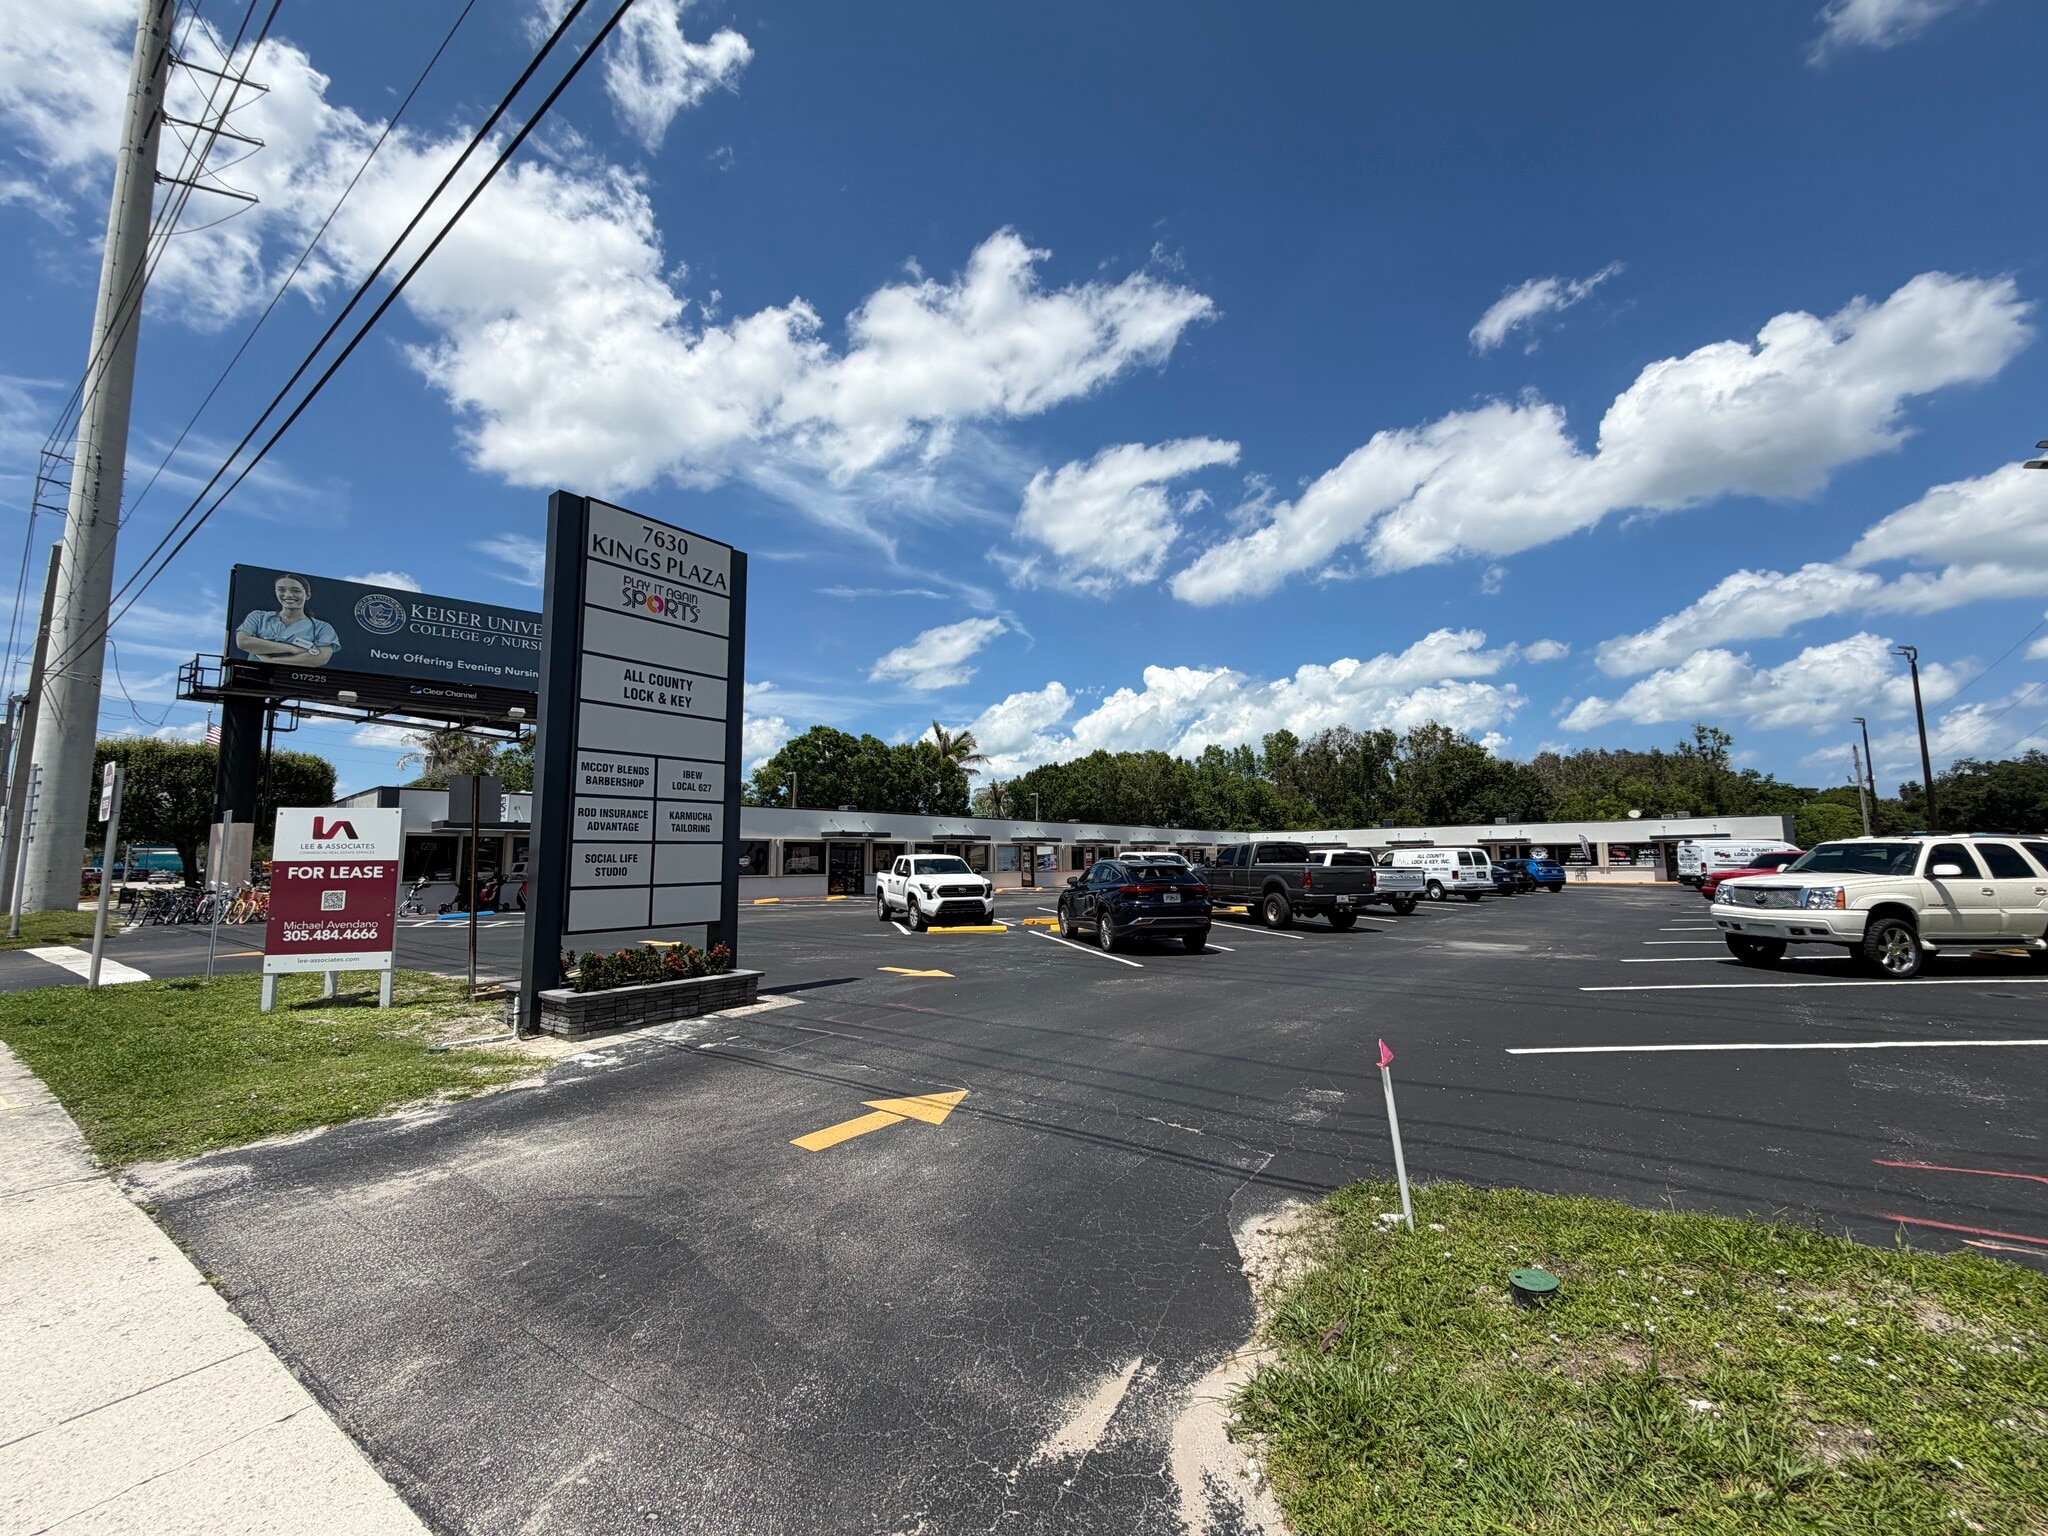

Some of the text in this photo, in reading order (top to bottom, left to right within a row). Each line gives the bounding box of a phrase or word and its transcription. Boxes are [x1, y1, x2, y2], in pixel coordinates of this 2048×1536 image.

[642, 525, 688, 556] 7630
[592, 533, 727, 591] KINGS PLAZA
[623, 575, 698, 605] PLAY IT AGAIN
[622, 586, 700, 624] SPORTS
[410, 603, 482, 628] KEISER
[409, 623, 480, 642] COLLEGE
[483, 635, 498, 646] of
[370, 648, 400, 662] Now
[403, 653, 454, 670] Offering
[457, 660, 502, 676] Evening
[292, 672, 327, 684] 017225
[624, 668, 693, 692] ALL COUNTY
[422, 687, 478, 700] Clear Channel
[624, 686, 692, 708] LOCK & KEY
[581, 762, 650, 776] MCCOY BLENDS
[683, 770, 702, 780] IBEW
[586, 776, 644, 788] BARBERSHOP
[672, 782, 712, 792] LOCAL 627
[578, 808, 648, 820] ROD INSURANCE
[669, 811, 712, 821] KARMUCHA
[587, 822, 640, 832] ADVANTAGE
[671, 824, 710, 832] TAILORING
[584, 854, 638, 864] SOCIAL LIFE
[288, 866, 384, 880] FOR LEASE
[594, 866, 628, 876] STUDIO
[284, 920, 378, 930] Michael Avendano
[283, 929, 378, 941] 305.484.4666
